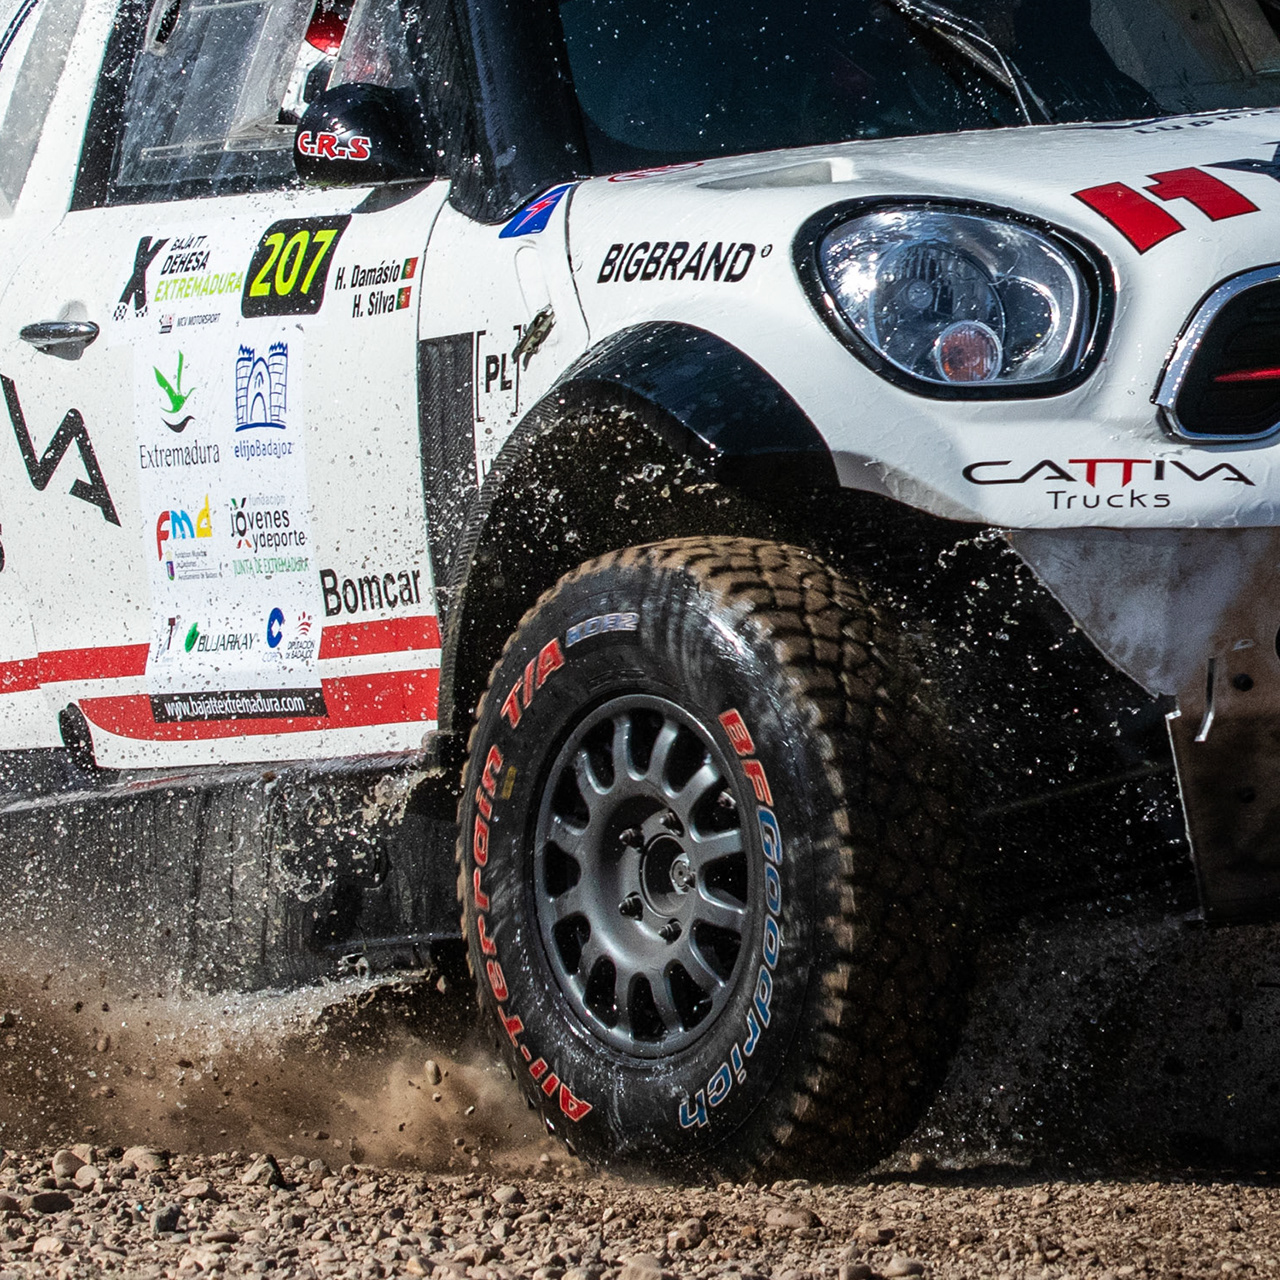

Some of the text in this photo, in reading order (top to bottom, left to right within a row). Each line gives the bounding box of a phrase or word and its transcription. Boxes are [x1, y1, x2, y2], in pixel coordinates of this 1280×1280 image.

[160, 250, 211, 276] DEHESA
[249, 228, 339, 298] 207
[335, 260, 401, 291] H. Damásio
[154, 271, 244, 303] EXTREMADURA
[352, 290, 396, 319] H. Silva
[139, 439, 221, 470] Extremadura
[234, 439, 293, 462] elijoBadajoz
[962, 458, 1256, 488] CATTIVA
[1046, 489, 1171, 510] Trucks
[252, 529, 307, 554] ydeporte
[319, 568, 421, 617] Bomcar
[164, 696, 306, 719] www.bajattextremadura.com
[473, 744, 593, 1123] All-Terrain
[679, 708, 783, 1130] BFGoodrich
